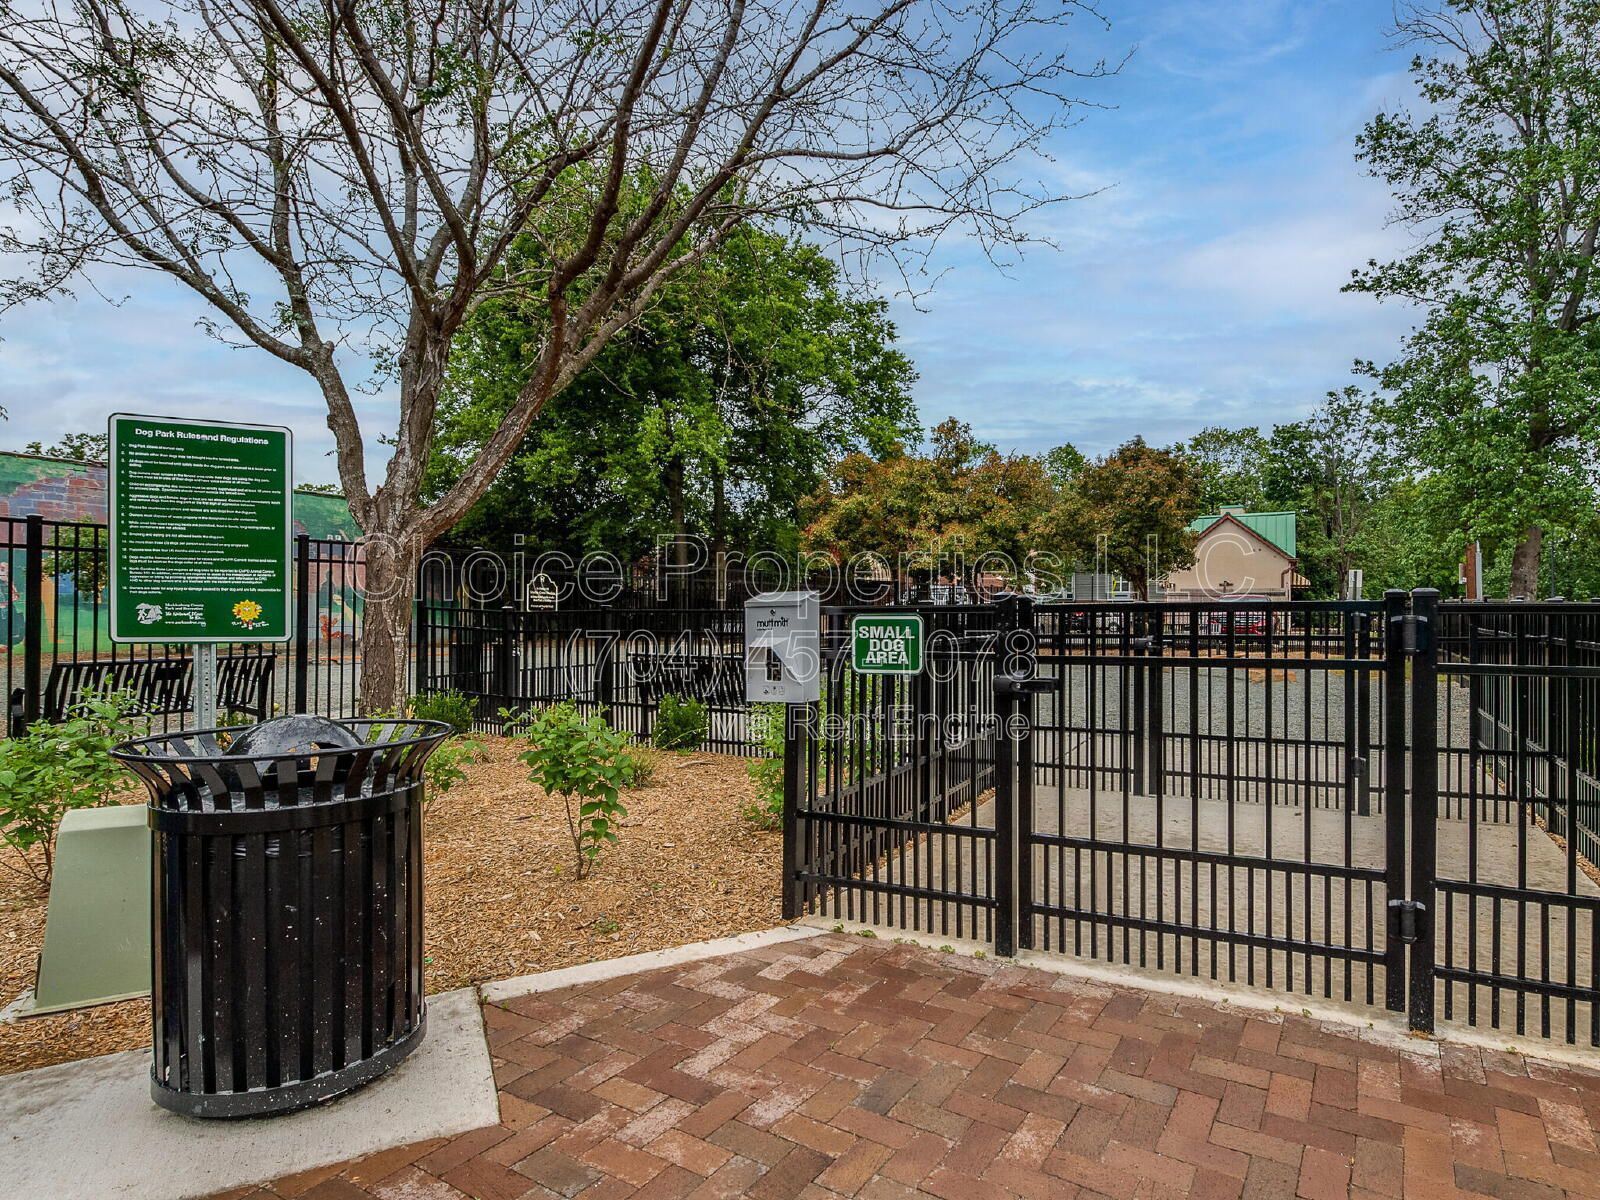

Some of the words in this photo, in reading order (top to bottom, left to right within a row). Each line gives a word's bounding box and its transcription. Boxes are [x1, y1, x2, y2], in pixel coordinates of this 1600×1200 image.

[135, 428, 153, 438] Dog
[155, 430, 175, 438] Park
[220, 434, 269, 445] Regulations
[859, 625, 915, 639] SMALL
[869, 639, 904, 651] DOG
[865, 651, 909, 665] AREA
